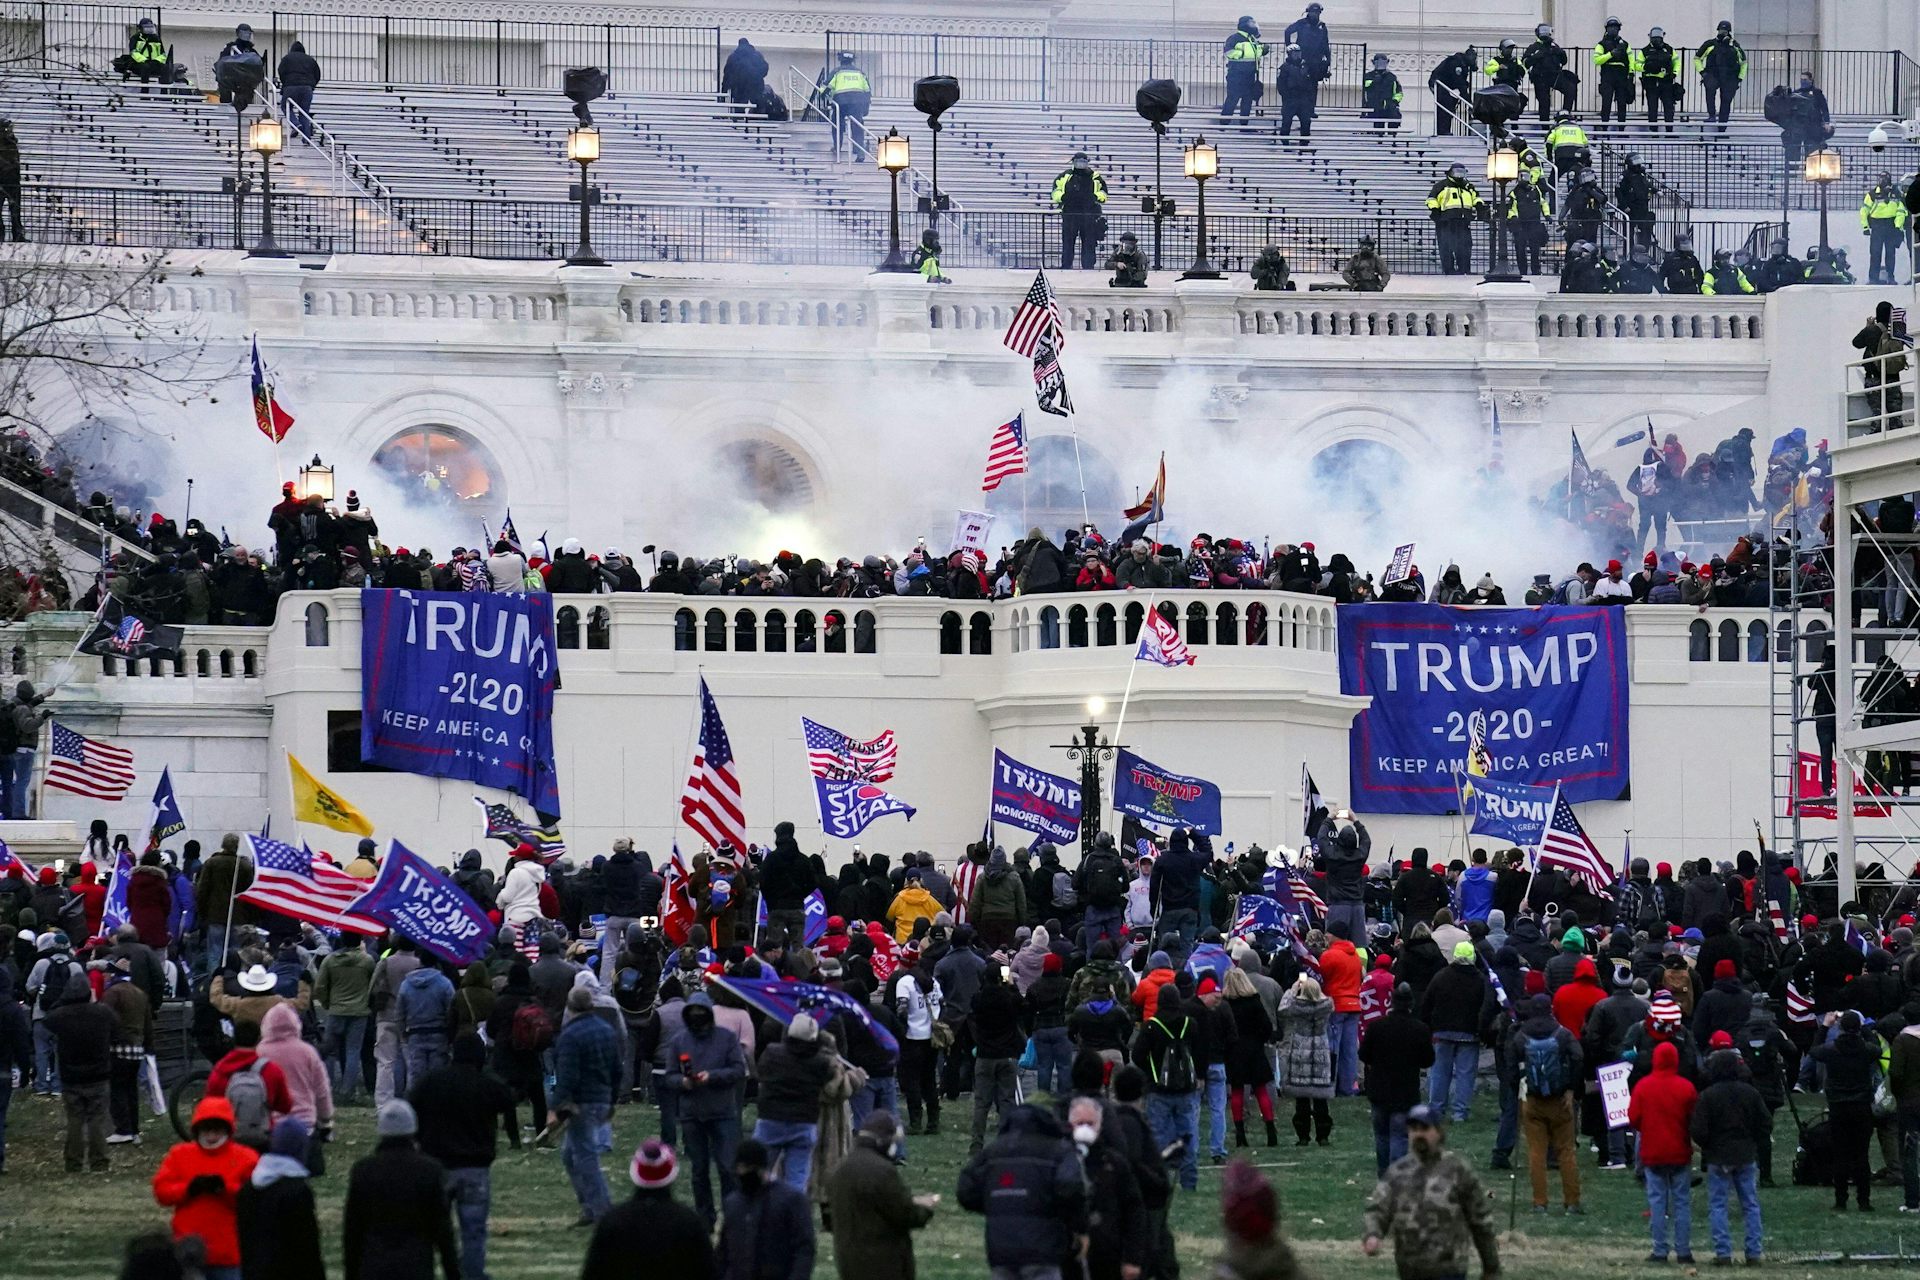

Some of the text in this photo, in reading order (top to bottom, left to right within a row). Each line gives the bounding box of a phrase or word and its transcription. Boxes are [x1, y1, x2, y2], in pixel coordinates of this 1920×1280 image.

[1371, 631, 1598, 694] TRUMP
[382, 708, 509, 747] KEEP AMERCA
[1378, 742, 1609, 773] KEEP AMICA GREAT!
[826, 783, 850, 792] FIGHT
[999, 759, 1082, 810] TRUMP
[1131, 768, 1202, 802] TRUMP
[832, 798, 904, 837] STEAL
[1125, 803, 1145, 814] KEEP
[399, 865, 481, 940] TRUMP
[1601, 1070, 1623, 1082] KEEP
[1606, 1091, 1618, 1101] TO
